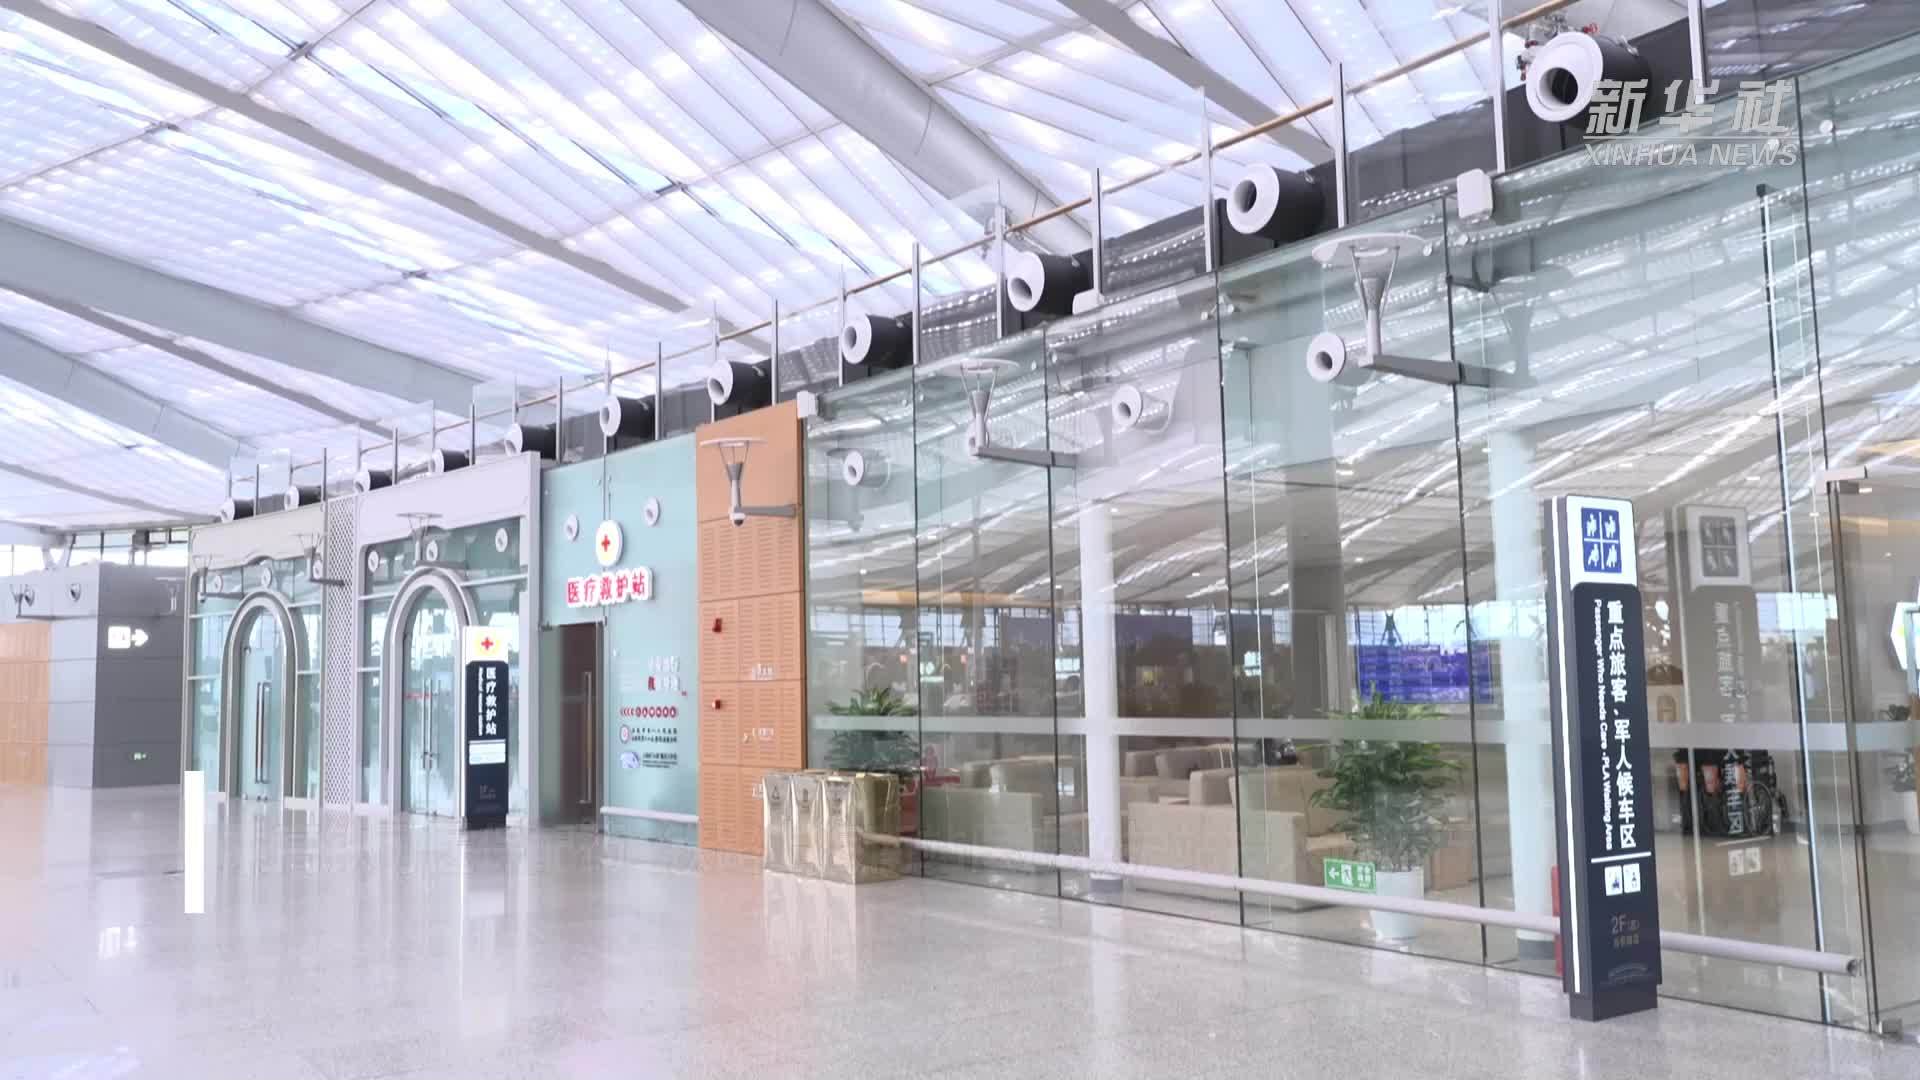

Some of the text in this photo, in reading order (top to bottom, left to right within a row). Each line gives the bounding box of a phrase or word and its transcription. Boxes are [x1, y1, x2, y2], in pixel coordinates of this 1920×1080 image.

[566, 568, 648, 605] 医疗救护站
[1597, 658, 1605, 684] Who
[485, 666, 497, 736] 医疗救护站
[1600, 722, 1608, 750] Care
[1603, 780, 1612, 823] Waiting
[1605, 823, 1614, 851] Area
